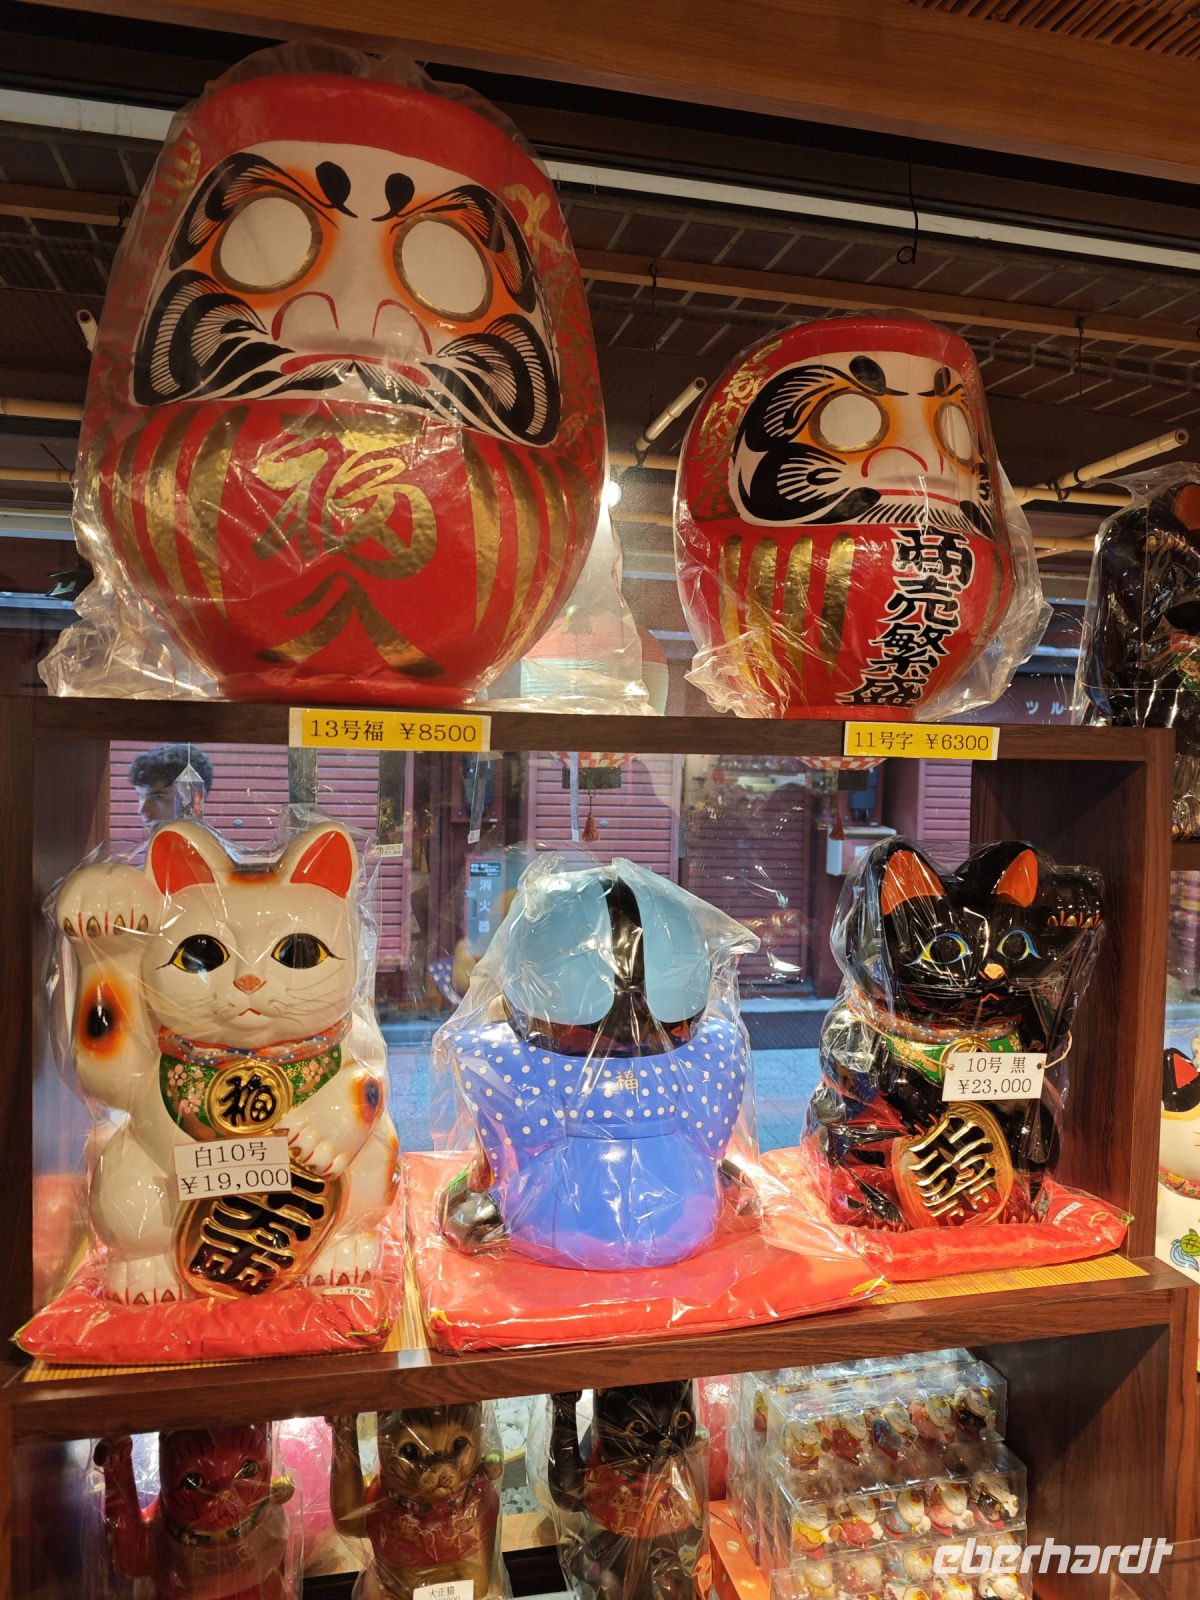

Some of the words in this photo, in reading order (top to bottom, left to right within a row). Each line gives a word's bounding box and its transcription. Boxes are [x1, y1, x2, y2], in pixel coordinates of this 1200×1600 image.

[835, 526, 976, 709] 商売繁盛
[310, 719, 384, 742] 13号福
[400, 723, 476, 743] ¥8500
[855, 731, 913, 750] 11号字
[926, 733, 989, 751] ¥6300
[966, 1057, 1003, 1074] 10号
[1010, 1056, 1026, 1073] 黒
[957, 1078, 1032, 1094] ¥23,000
[217, 1073, 277, 1127] 福
[194, 1142, 268, 1168] 白10号
[180, 1168, 289, 1195] ¥19,000
